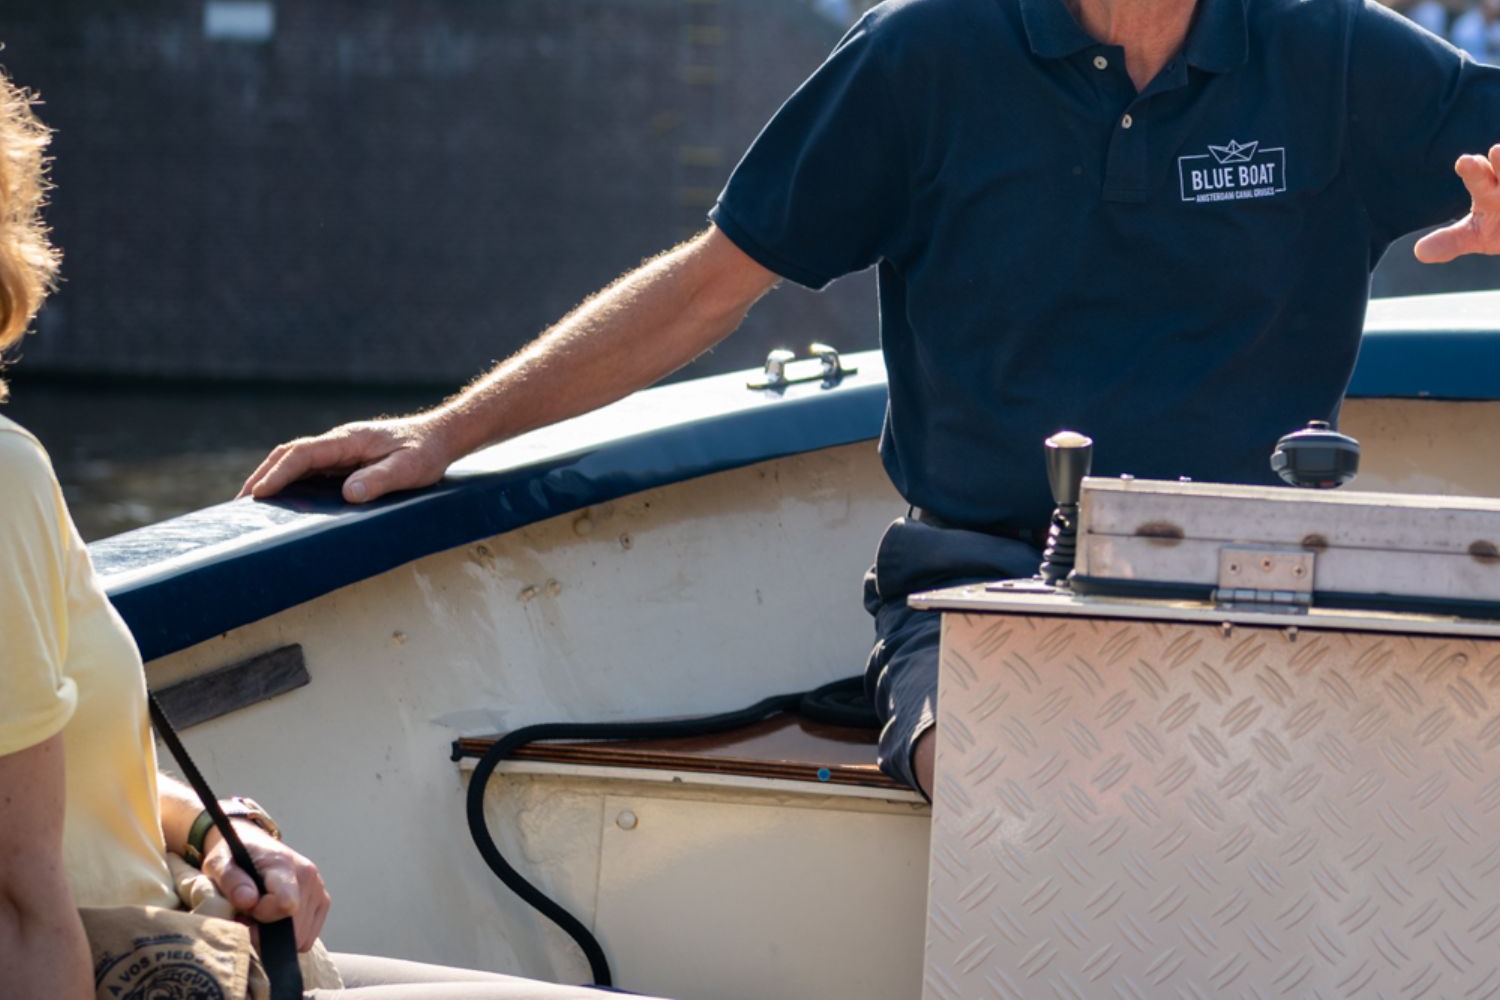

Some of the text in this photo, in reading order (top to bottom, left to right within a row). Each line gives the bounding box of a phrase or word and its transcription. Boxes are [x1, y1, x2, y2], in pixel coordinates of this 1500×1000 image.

[1192, 163, 1275, 190] BLUE BOAT
[119, 957, 150, 983] VOS
